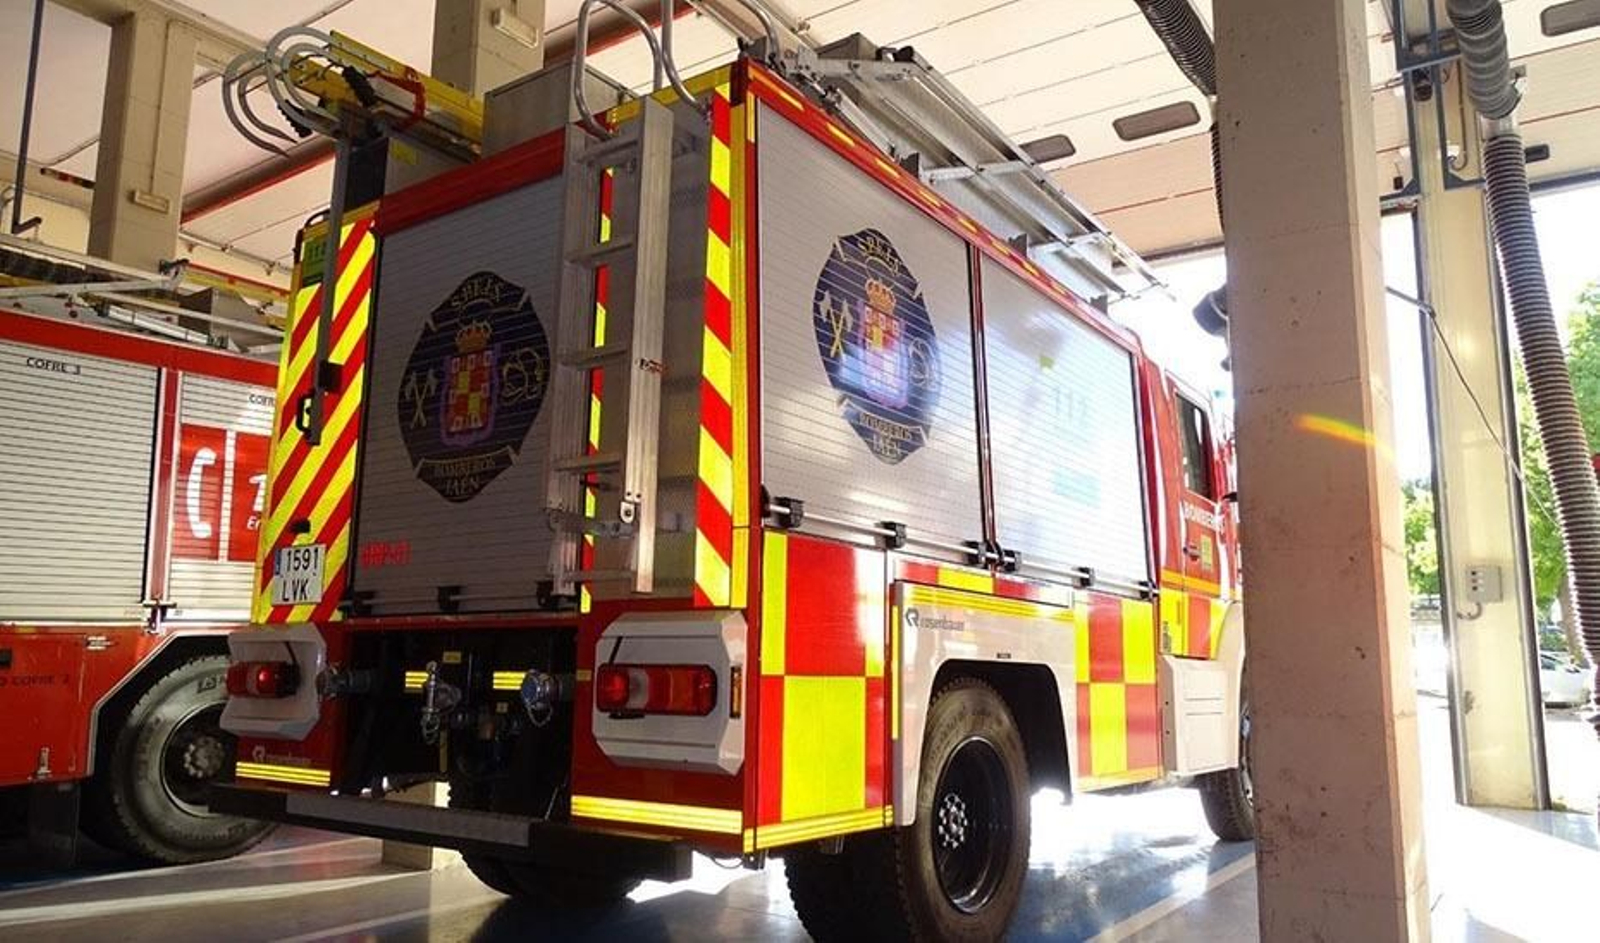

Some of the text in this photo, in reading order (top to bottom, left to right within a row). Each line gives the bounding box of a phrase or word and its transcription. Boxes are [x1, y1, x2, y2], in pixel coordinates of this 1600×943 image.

[26, 356, 67, 374] COFRE
[249, 393, 275, 407] COFR
[286, 546, 319, 572] 1591
[282, 578, 309, 602] LVK
